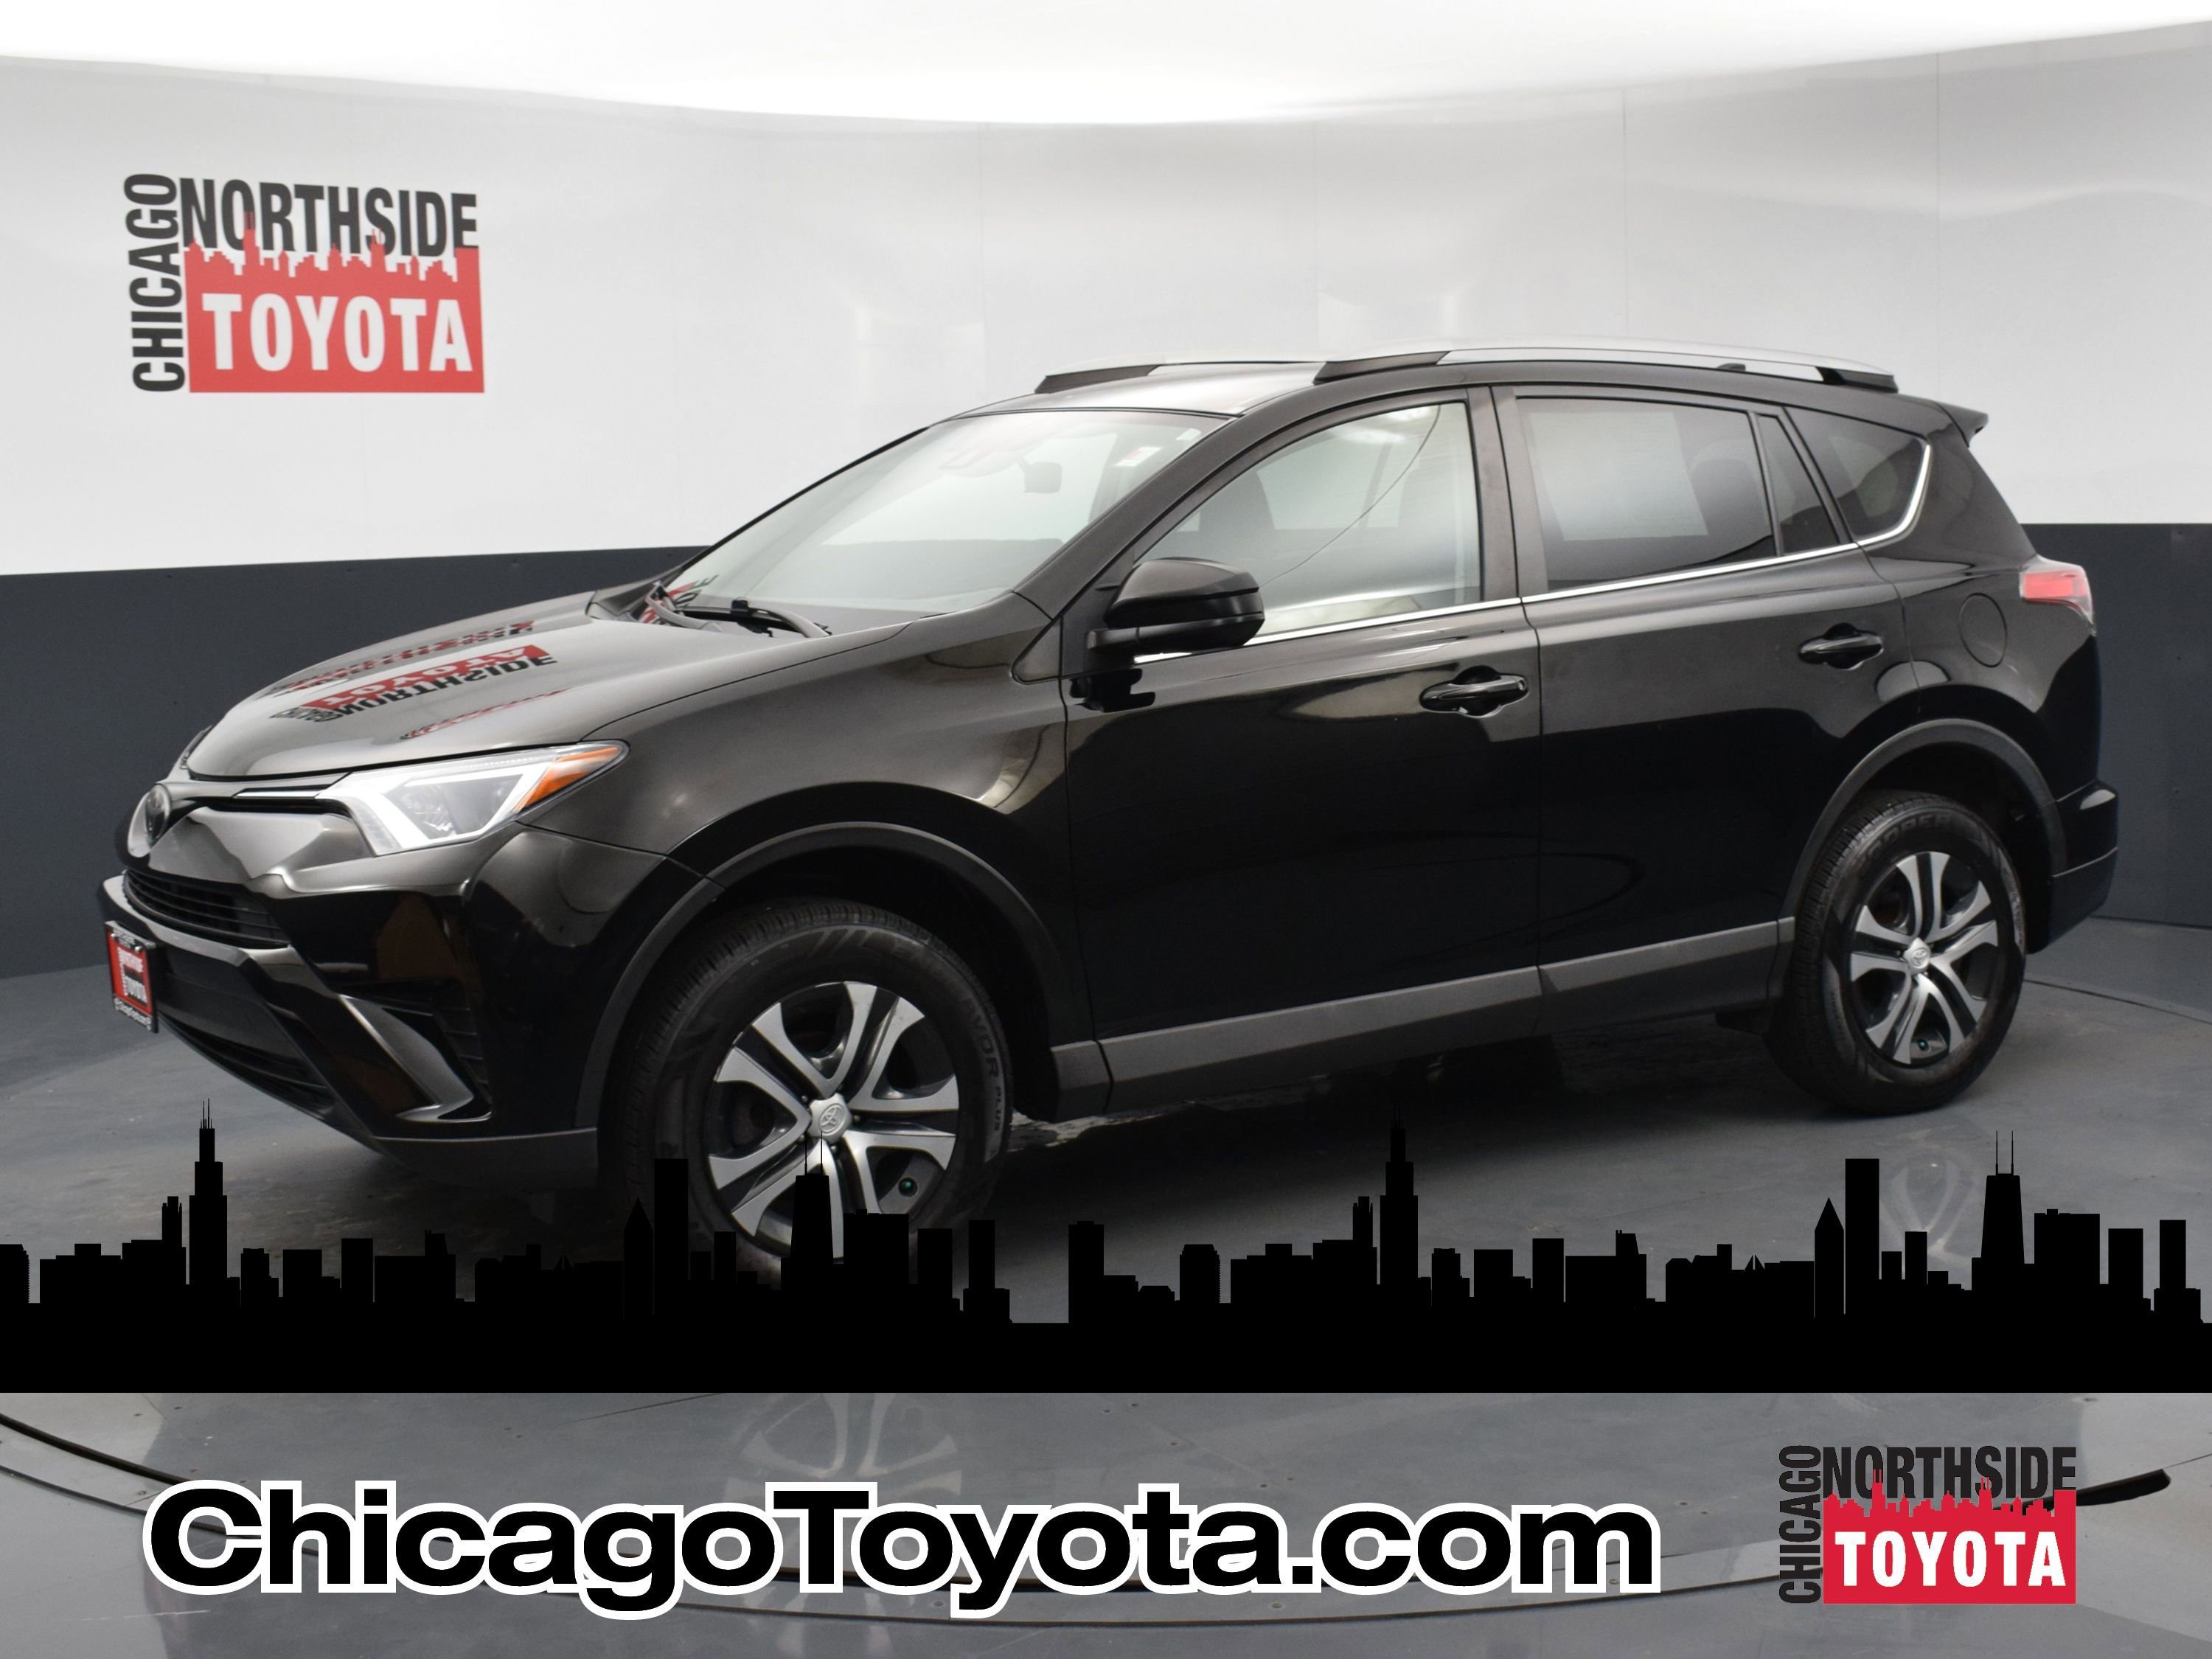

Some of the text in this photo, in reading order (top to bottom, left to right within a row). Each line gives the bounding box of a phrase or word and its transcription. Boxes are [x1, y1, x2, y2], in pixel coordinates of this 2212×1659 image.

[180, 178, 479, 257] NORTHSIDE
[124, 173, 184, 392] CHICAGO
[202, 293, 473, 372] TOYOTA
